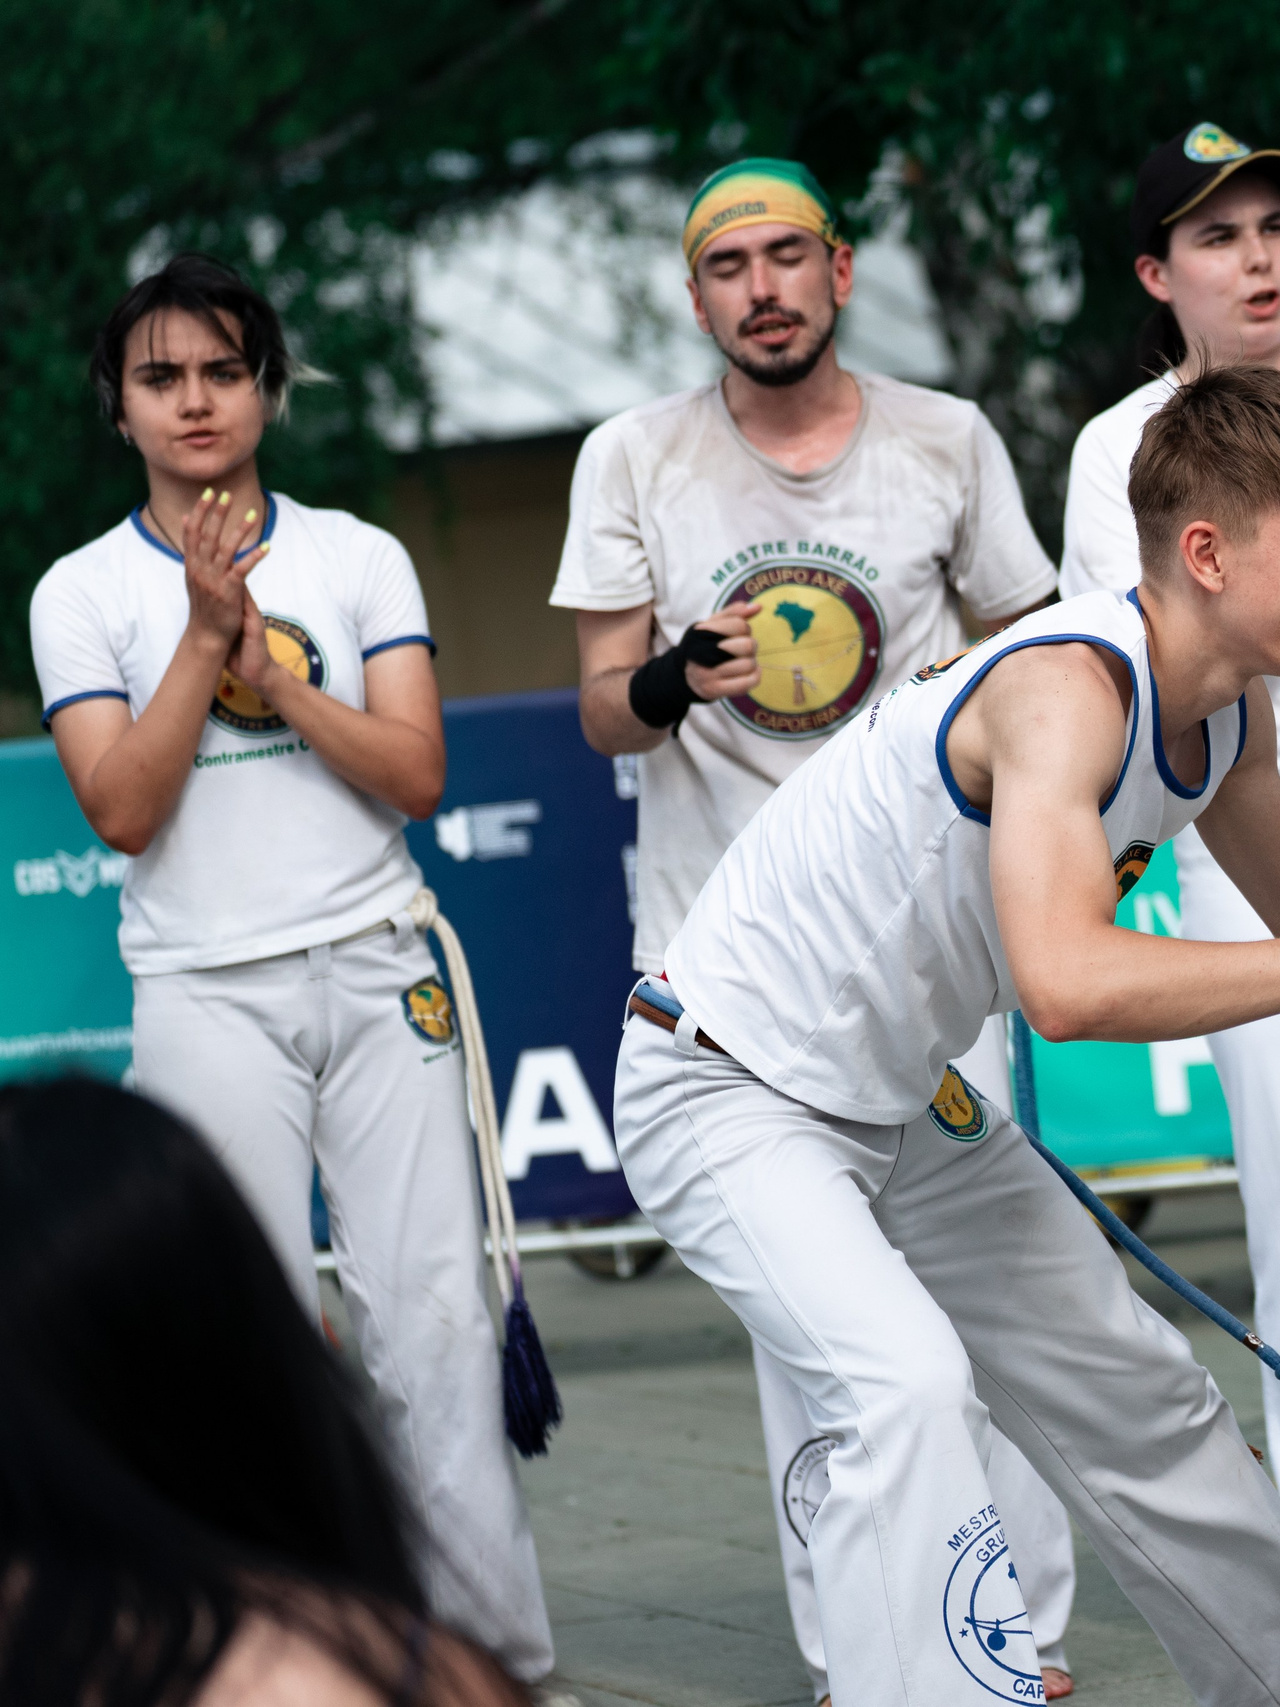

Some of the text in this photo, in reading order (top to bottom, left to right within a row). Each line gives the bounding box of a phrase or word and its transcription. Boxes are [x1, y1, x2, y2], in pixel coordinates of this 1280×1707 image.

[710, 541, 789, 587] MESTRE
[744, 567, 809, 596] GRUPO
[754, 706, 843, 732] CAPOEIRA
[194, 742, 296, 769] Contramestre
[947, 1503, 999, 1552] MESTR
[976, 1528, 1006, 1563] GRU
